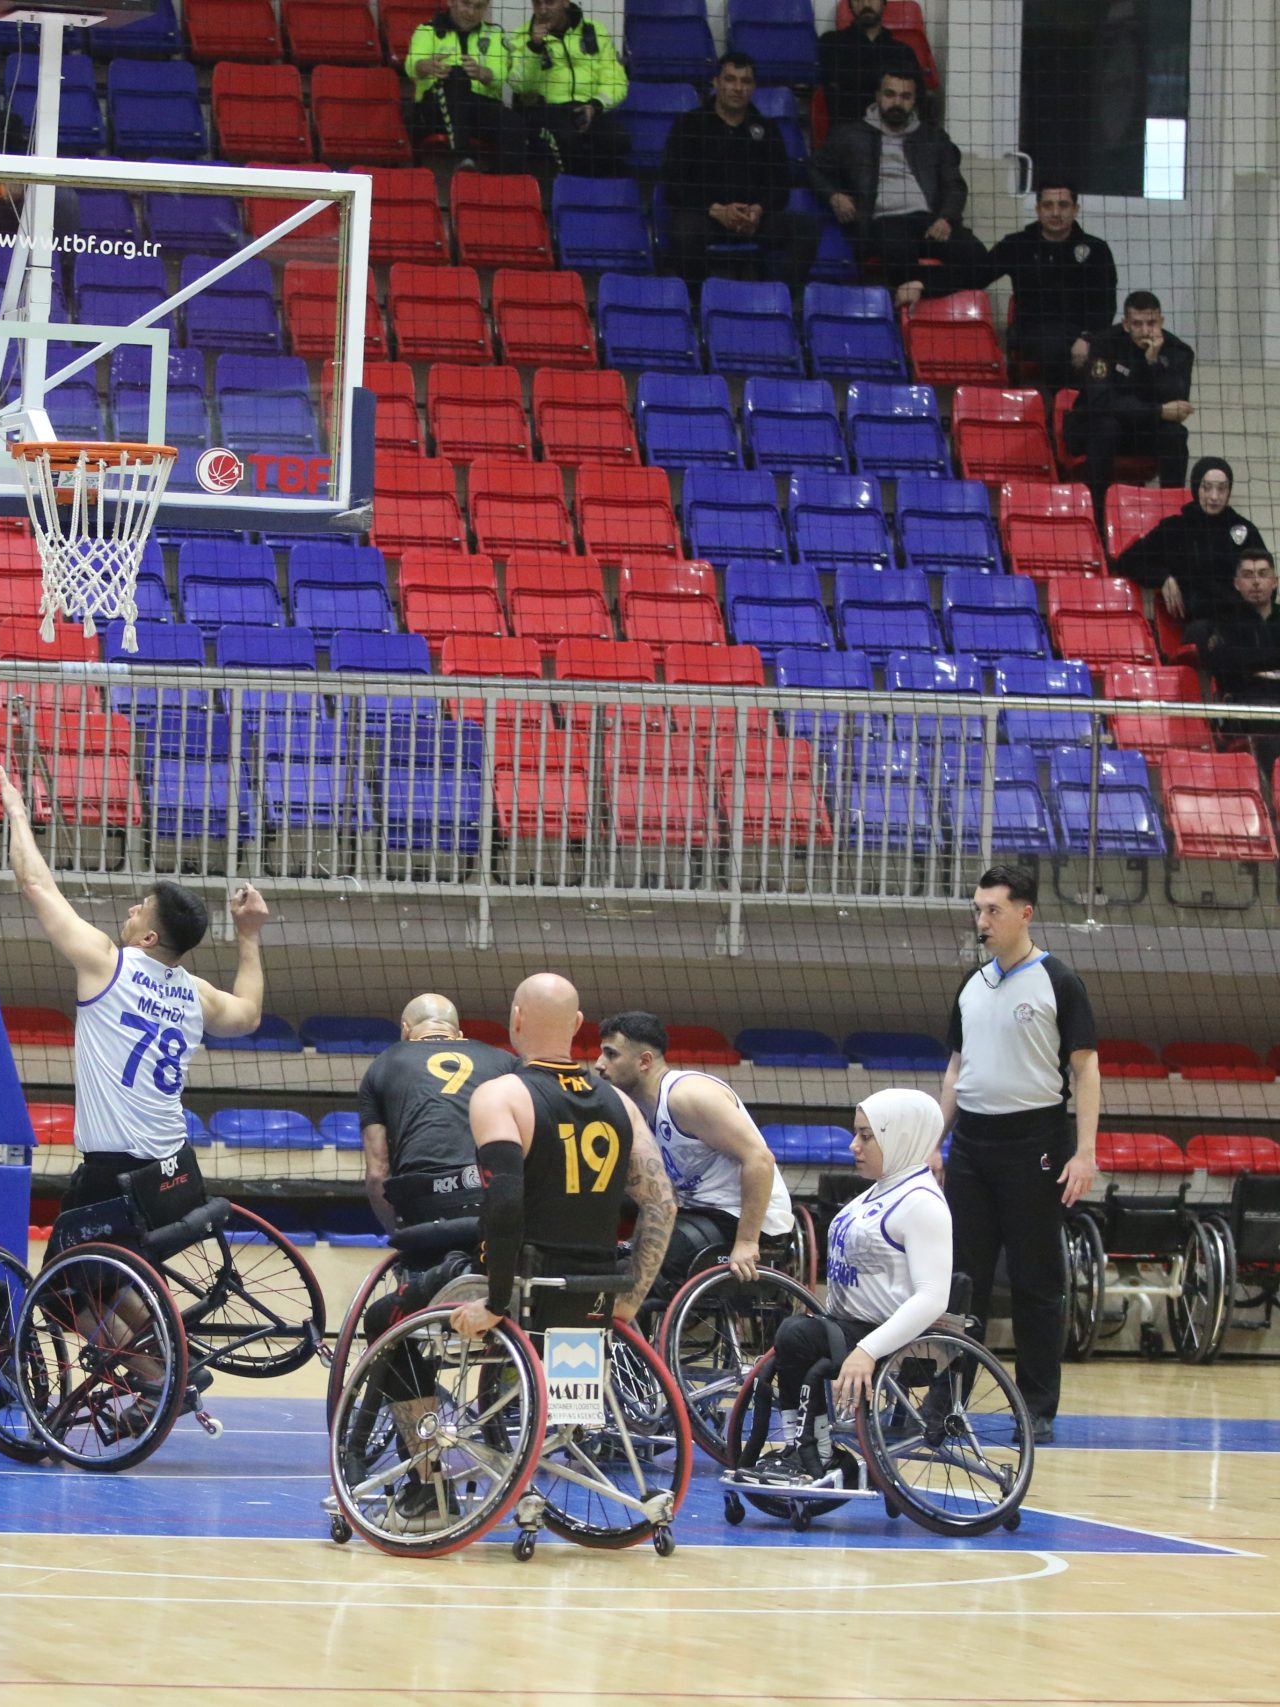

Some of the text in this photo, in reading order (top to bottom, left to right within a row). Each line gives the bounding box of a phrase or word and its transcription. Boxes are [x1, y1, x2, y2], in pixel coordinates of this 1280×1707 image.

[247, 453, 332, 493] TBF
[120, 1010, 187, 1096] 78
[426, 1051, 474, 1095] 9
[558, 1121, 620, 1194] 19
[160, 1173, 189, 1191] ELITE
[548, 1383, 599, 1400] MARTI
[795, 1384, 811, 1452] EXTRA
